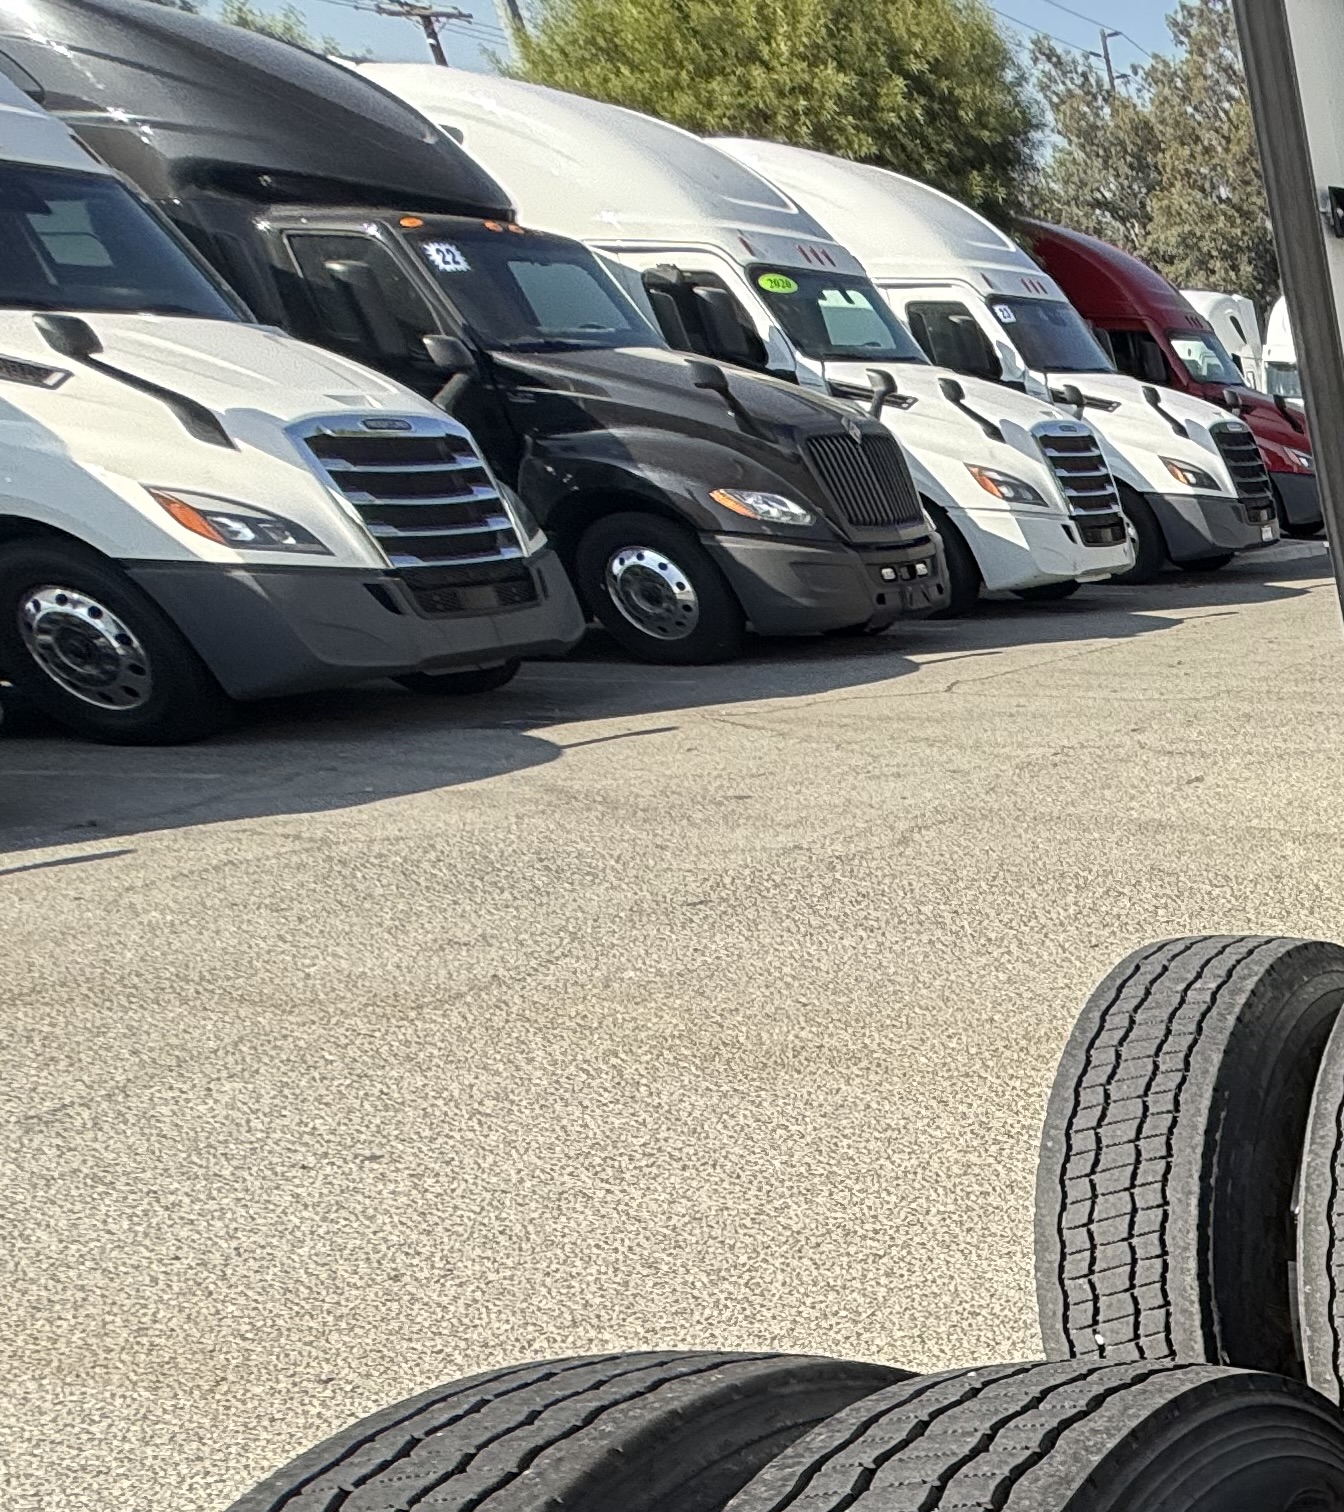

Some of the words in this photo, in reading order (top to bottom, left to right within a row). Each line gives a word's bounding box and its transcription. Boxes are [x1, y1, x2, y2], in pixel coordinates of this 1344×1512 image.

[435, 247, 462, 266] 22
[766, 278, 792, 289] 2020
[998, 307, 1012, 319] 23
